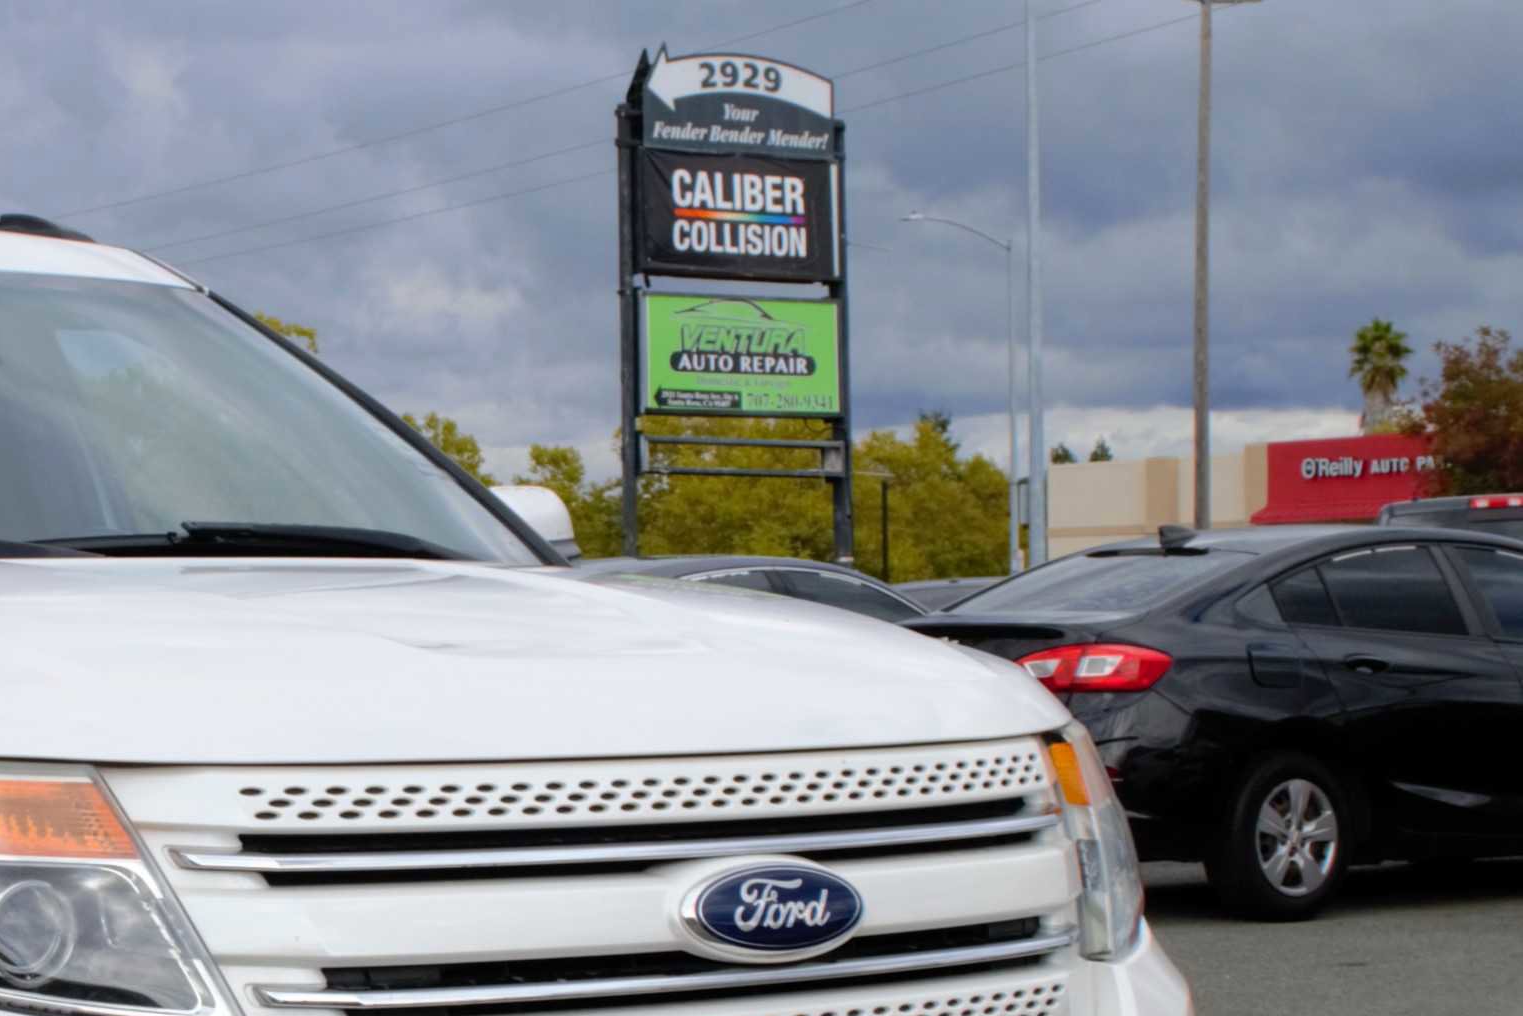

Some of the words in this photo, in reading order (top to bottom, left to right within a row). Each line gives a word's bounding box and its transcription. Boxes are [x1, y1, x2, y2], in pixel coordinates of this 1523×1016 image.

[699, 62, 782, 93] 2929
[723, 103, 759, 122] Your
[653, 121, 708, 142] Fender
[709, 126, 765, 146] Bender
[767, 129, 829, 150] Mender!
[672, 169, 805, 214] CALIBER
[672, 219, 807, 258] COLLISION
[680, 323, 806, 354] VENTURA
[678, 353, 734, 372] AUTO
[740, 356, 809, 374] REPAIR
[1301, 456, 1363, 479] O'Reilly
[1370, 457, 1410, 474] AUTO
[734, 878, 831, 932] Ford
